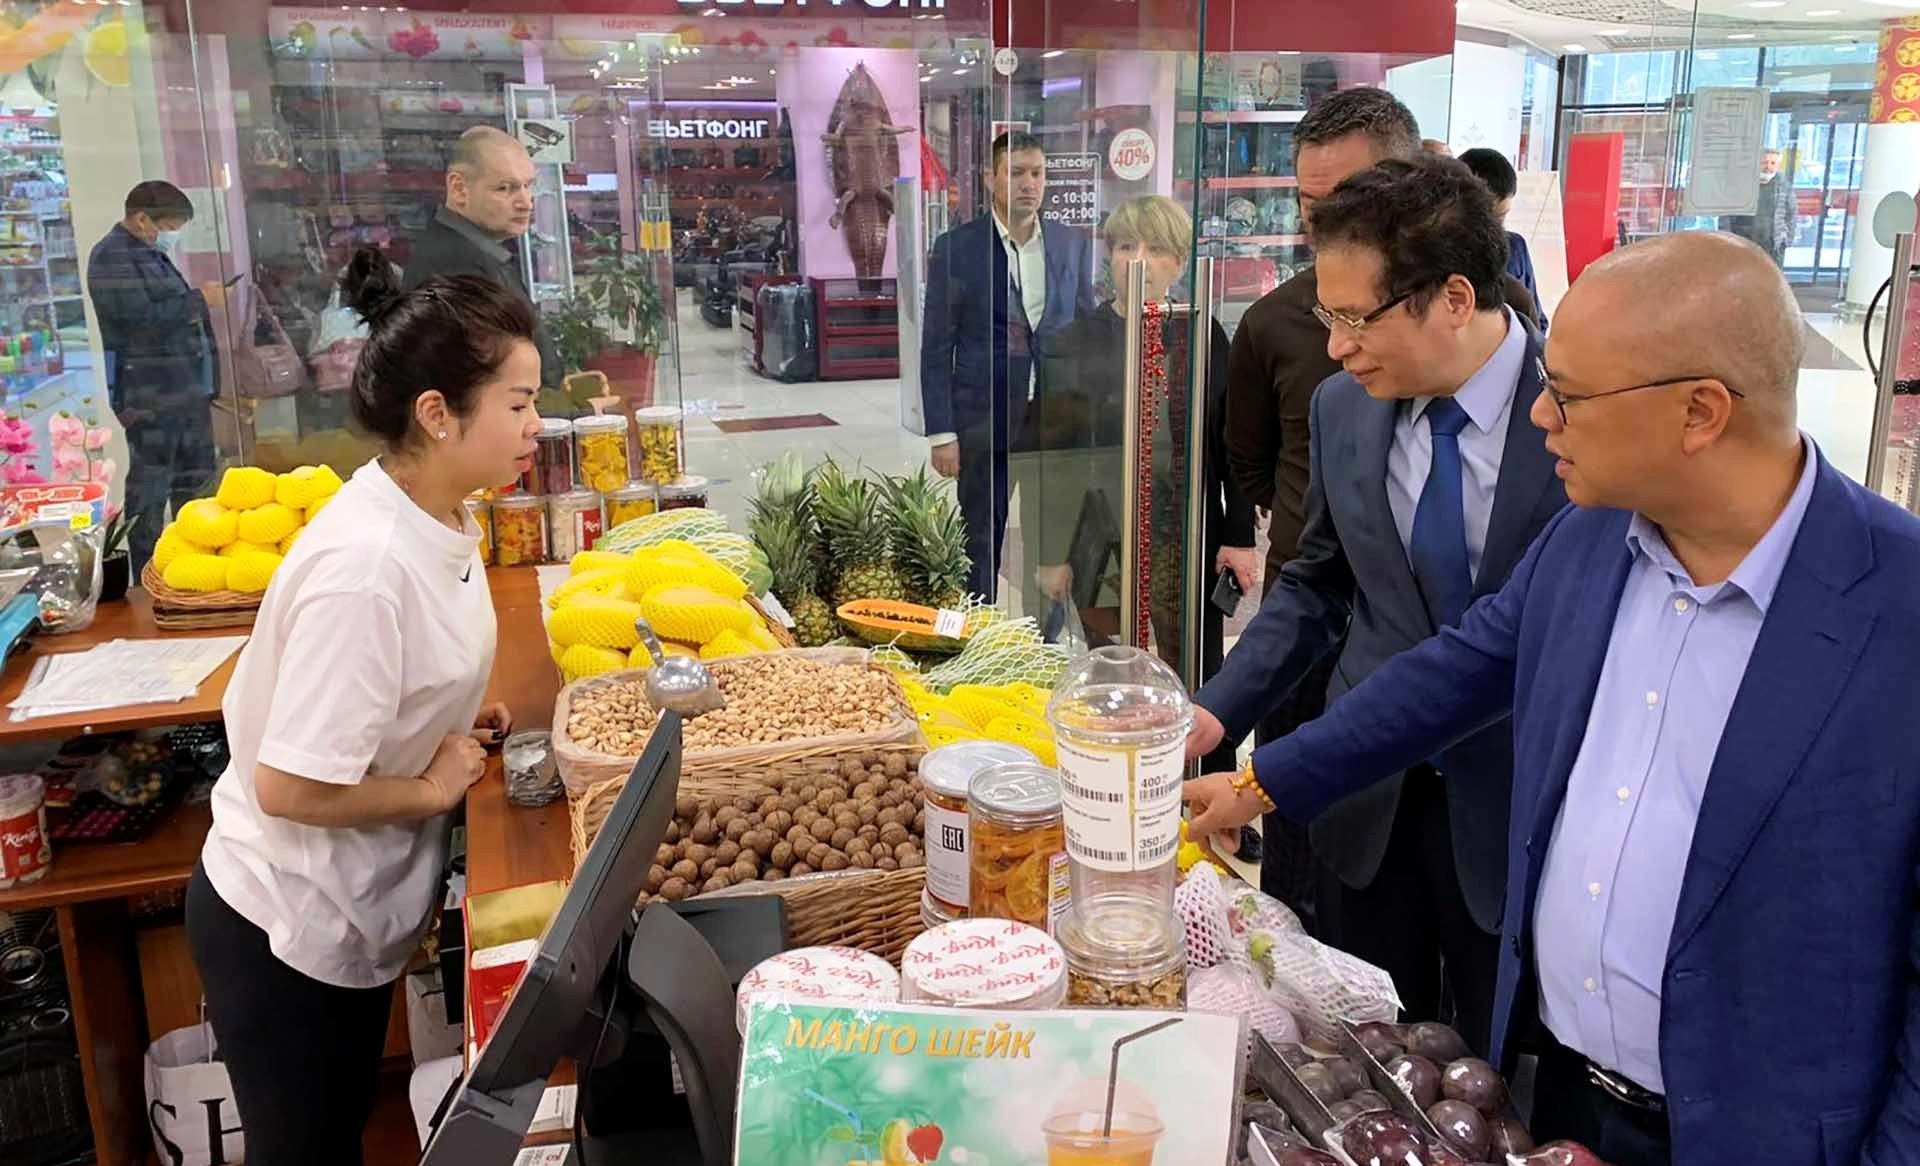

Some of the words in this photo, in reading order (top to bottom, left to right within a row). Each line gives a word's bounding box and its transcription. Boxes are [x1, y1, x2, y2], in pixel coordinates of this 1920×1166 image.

[1114, 145, 1150, 167] 40%
[1047, 158, 1094, 169] ЬЕТФОНГ
[1063, 191, 1096, 204] 10:00
[1061, 207, 1096, 220] 21:00
[1140, 774, 1161, 788] 400
[1139, 836, 1159, 849] 350
[785, 1017, 918, 1056] МАНГО
[926, 1021, 1037, 1059] ШЕЙК
